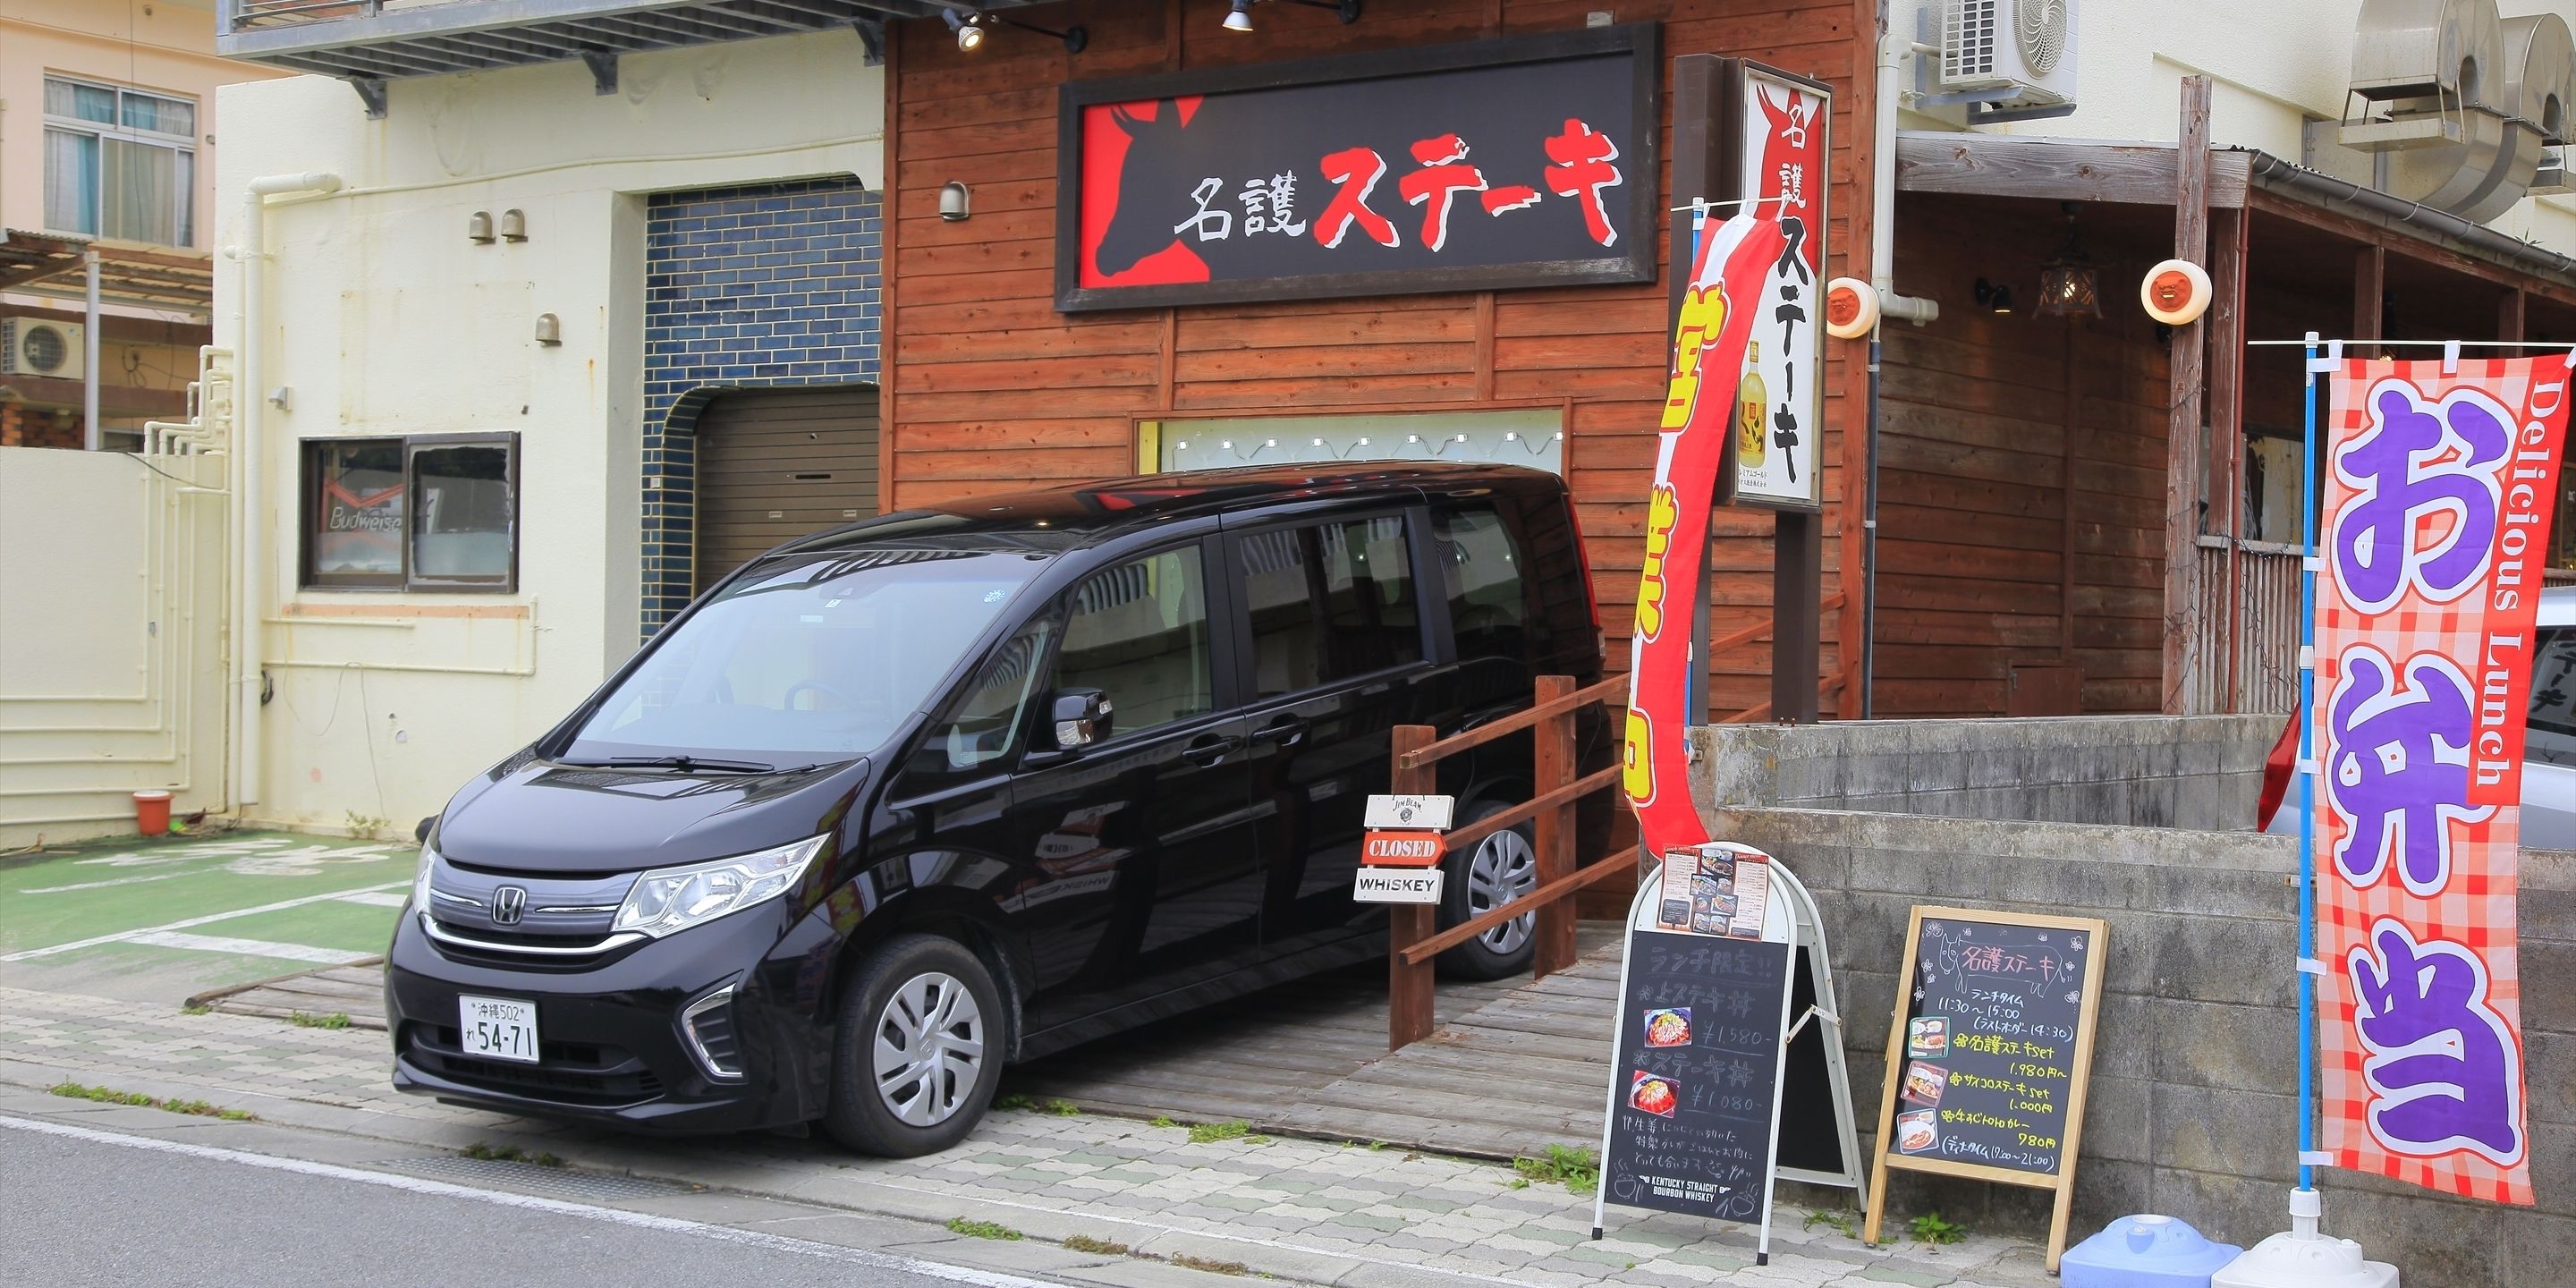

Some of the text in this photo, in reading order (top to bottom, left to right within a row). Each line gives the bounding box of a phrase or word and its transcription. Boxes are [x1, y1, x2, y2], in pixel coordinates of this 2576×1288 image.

[1174, 118, 1623, 252] 名護ステーキ
[1775, 103, 1808, 484] 名護ステーキ
[2475, 377, 2564, 787] Delicious Lunch
[2329, 385, 2519, 1159] お弁当
[1368, 839, 1436, 858] CLOSED
[1360, 878, 1436, 892] WHISKEY
[1962, 945, 2055, 981] 名護ステーキ
[1970, 988, 2025, 1008] ランチタイム
[478, 1021, 531, 1056] 54-71
[2018, 1132, 2056, 1149] 780円
[1651, 1175, 1718, 1194] KENTUCKY STRAIGHT
[1653, 1185, 1715, 1203] BOURBON WHISKEY
